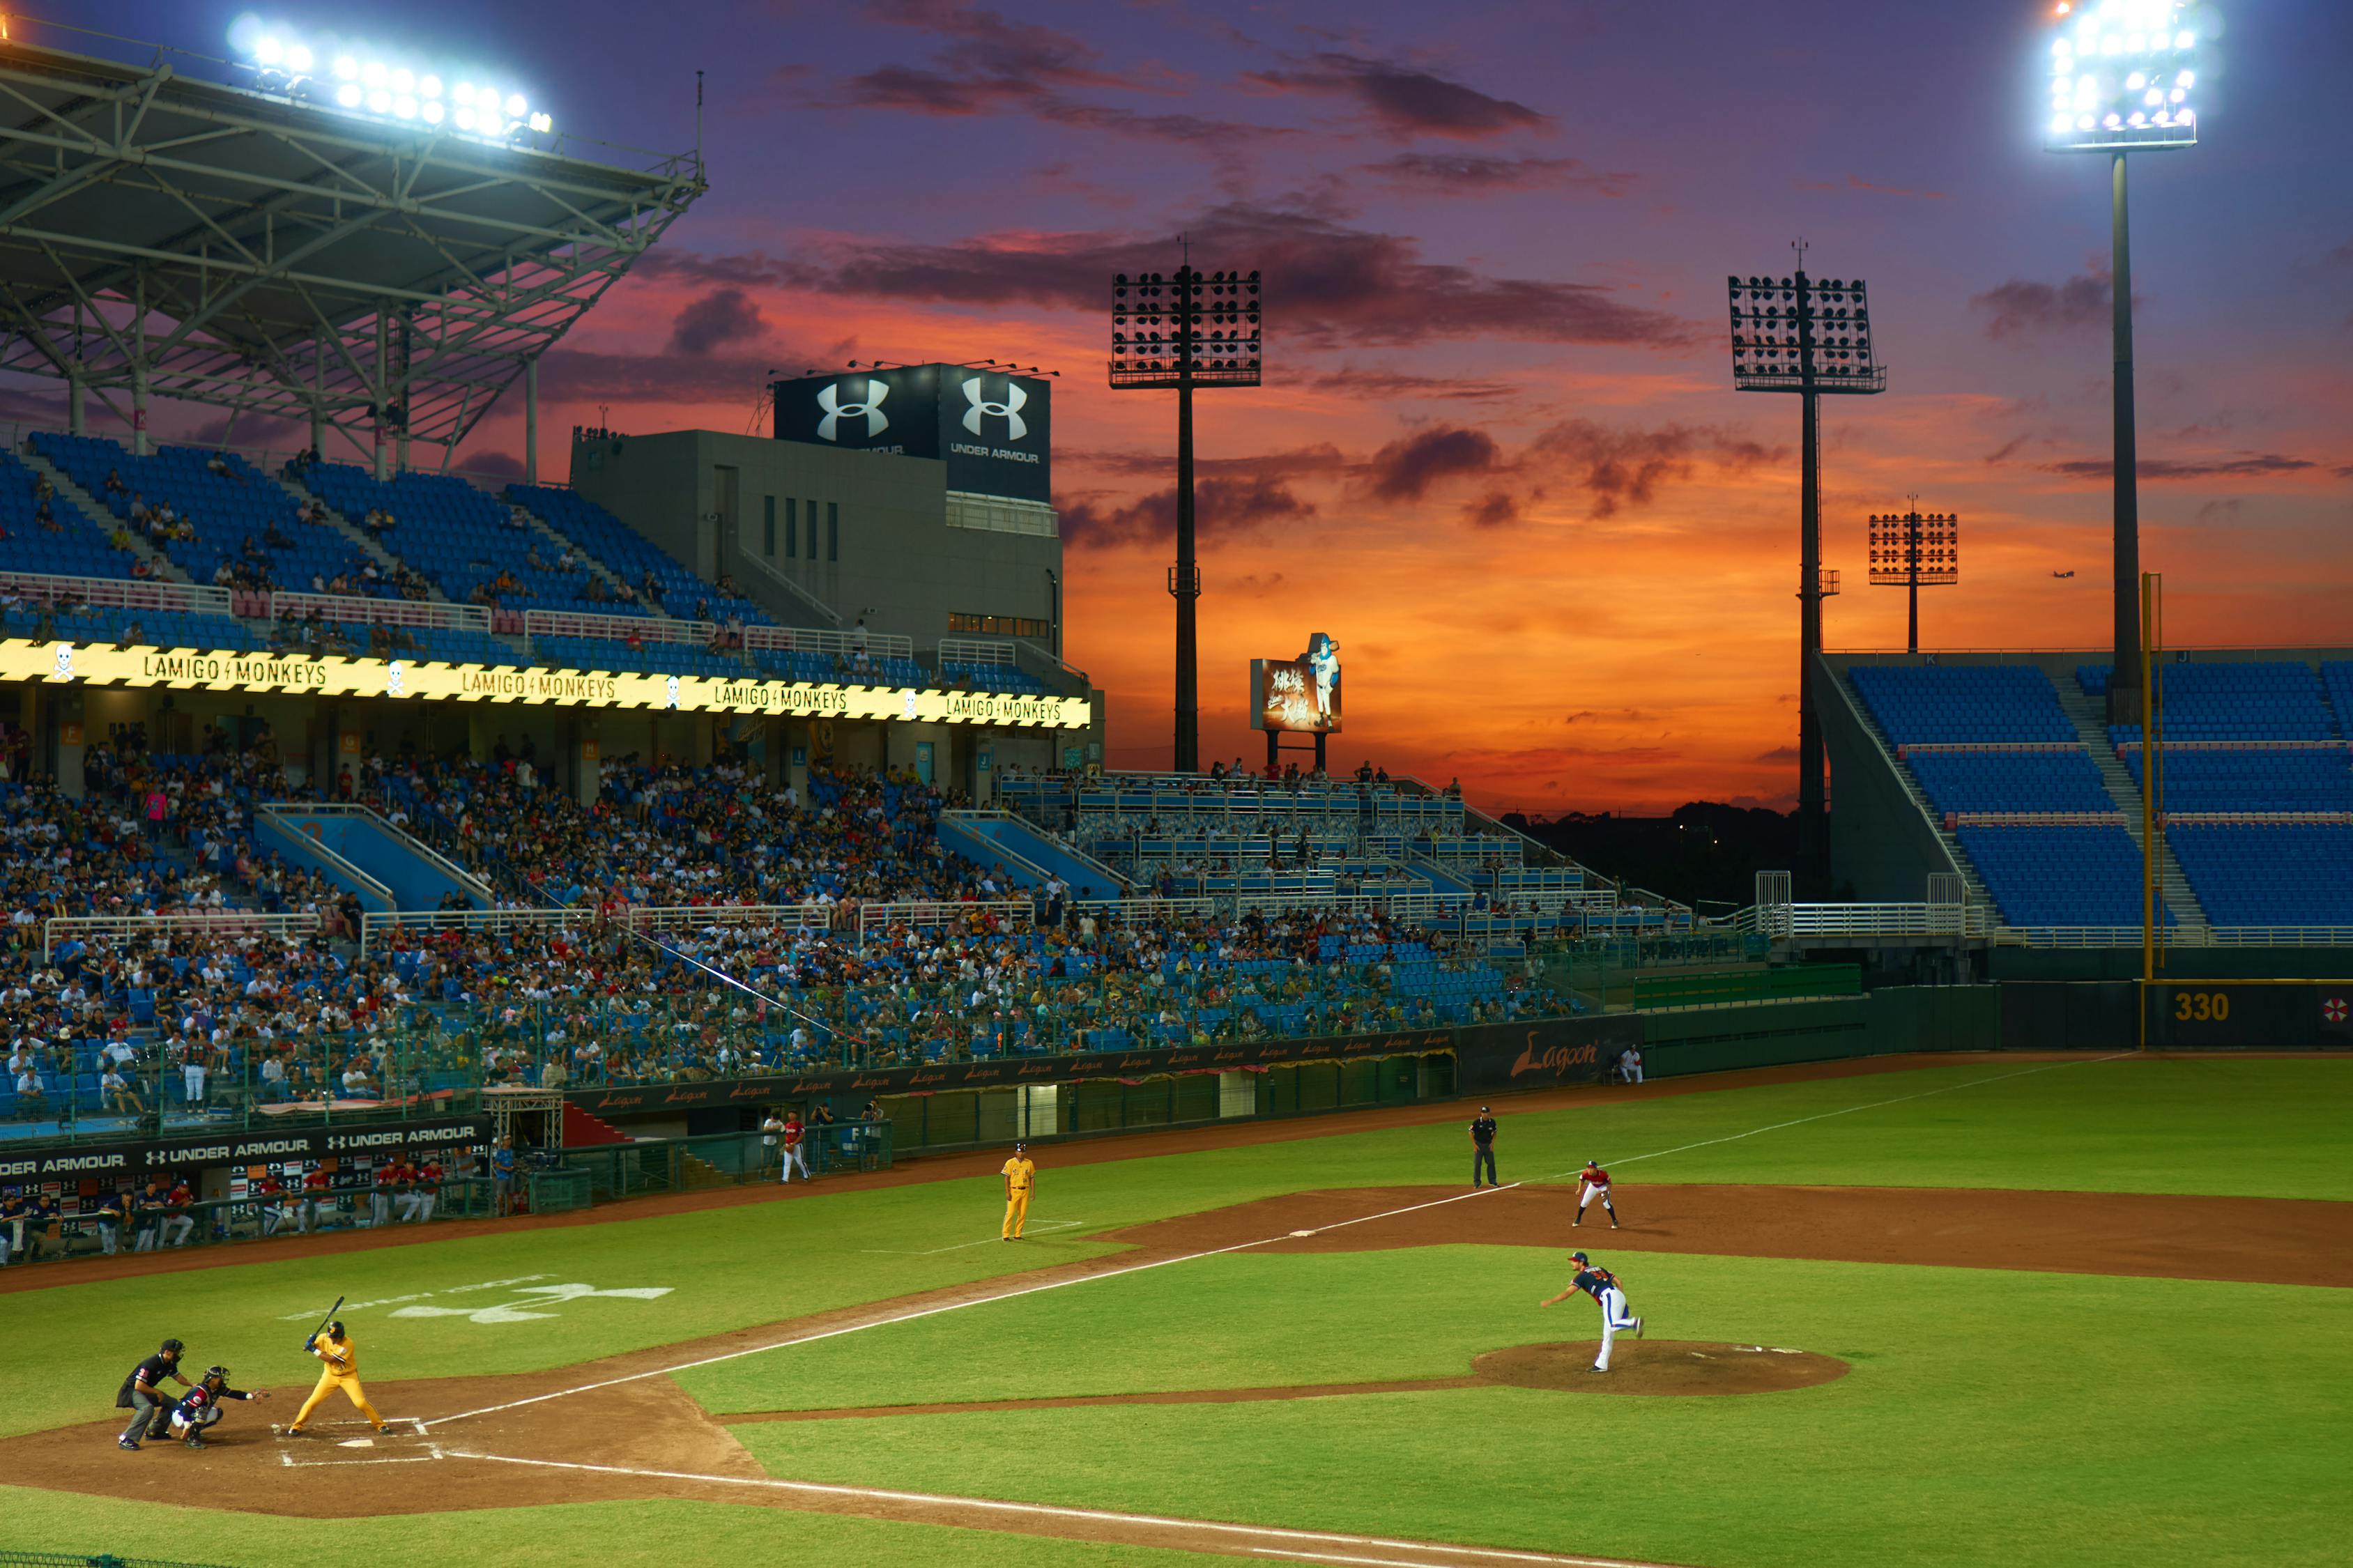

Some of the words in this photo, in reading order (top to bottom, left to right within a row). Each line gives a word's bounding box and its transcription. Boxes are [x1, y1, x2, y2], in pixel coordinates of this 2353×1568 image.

[951, 443, 989, 456] UNDER
[991, 448, 1038, 463] ARMOUR
[1926, 654, 1935, 665] K
[2178, 652, 2187, 663] J
[144, 656, 219, 679] LAMIGO
[237, 661, 325, 684] MONKEYS
[463, 673, 525, 693] LAMIGO
[539, 677, 615, 698] MONKEYS
[715, 686, 768, 705] LAMIGO
[781, 690, 846, 709] MONKEYS
[946, 699, 993, 716] LAMIGO
[1004, 702, 1060, 720] MONKEYS
[68, 724, 76, 739] F
[345, 735, 355, 746] G
[587, 741, 595, 754] H
[981, 755, 986, 765] J
[2175, 992, 2229, 1021] 330
[1510, 1031, 1599, 1080] Lagoon
[348, 1132, 403, 1148] UNDER
[406, 1126, 475, 1143] ARMOUR
[169, 1146, 229, 1162] UNDER
[234, 1139, 309, 1157] ARMOUR
[0, 1160, 36, 1176] DER
[42, 1155, 125, 1173] ARMOUR
